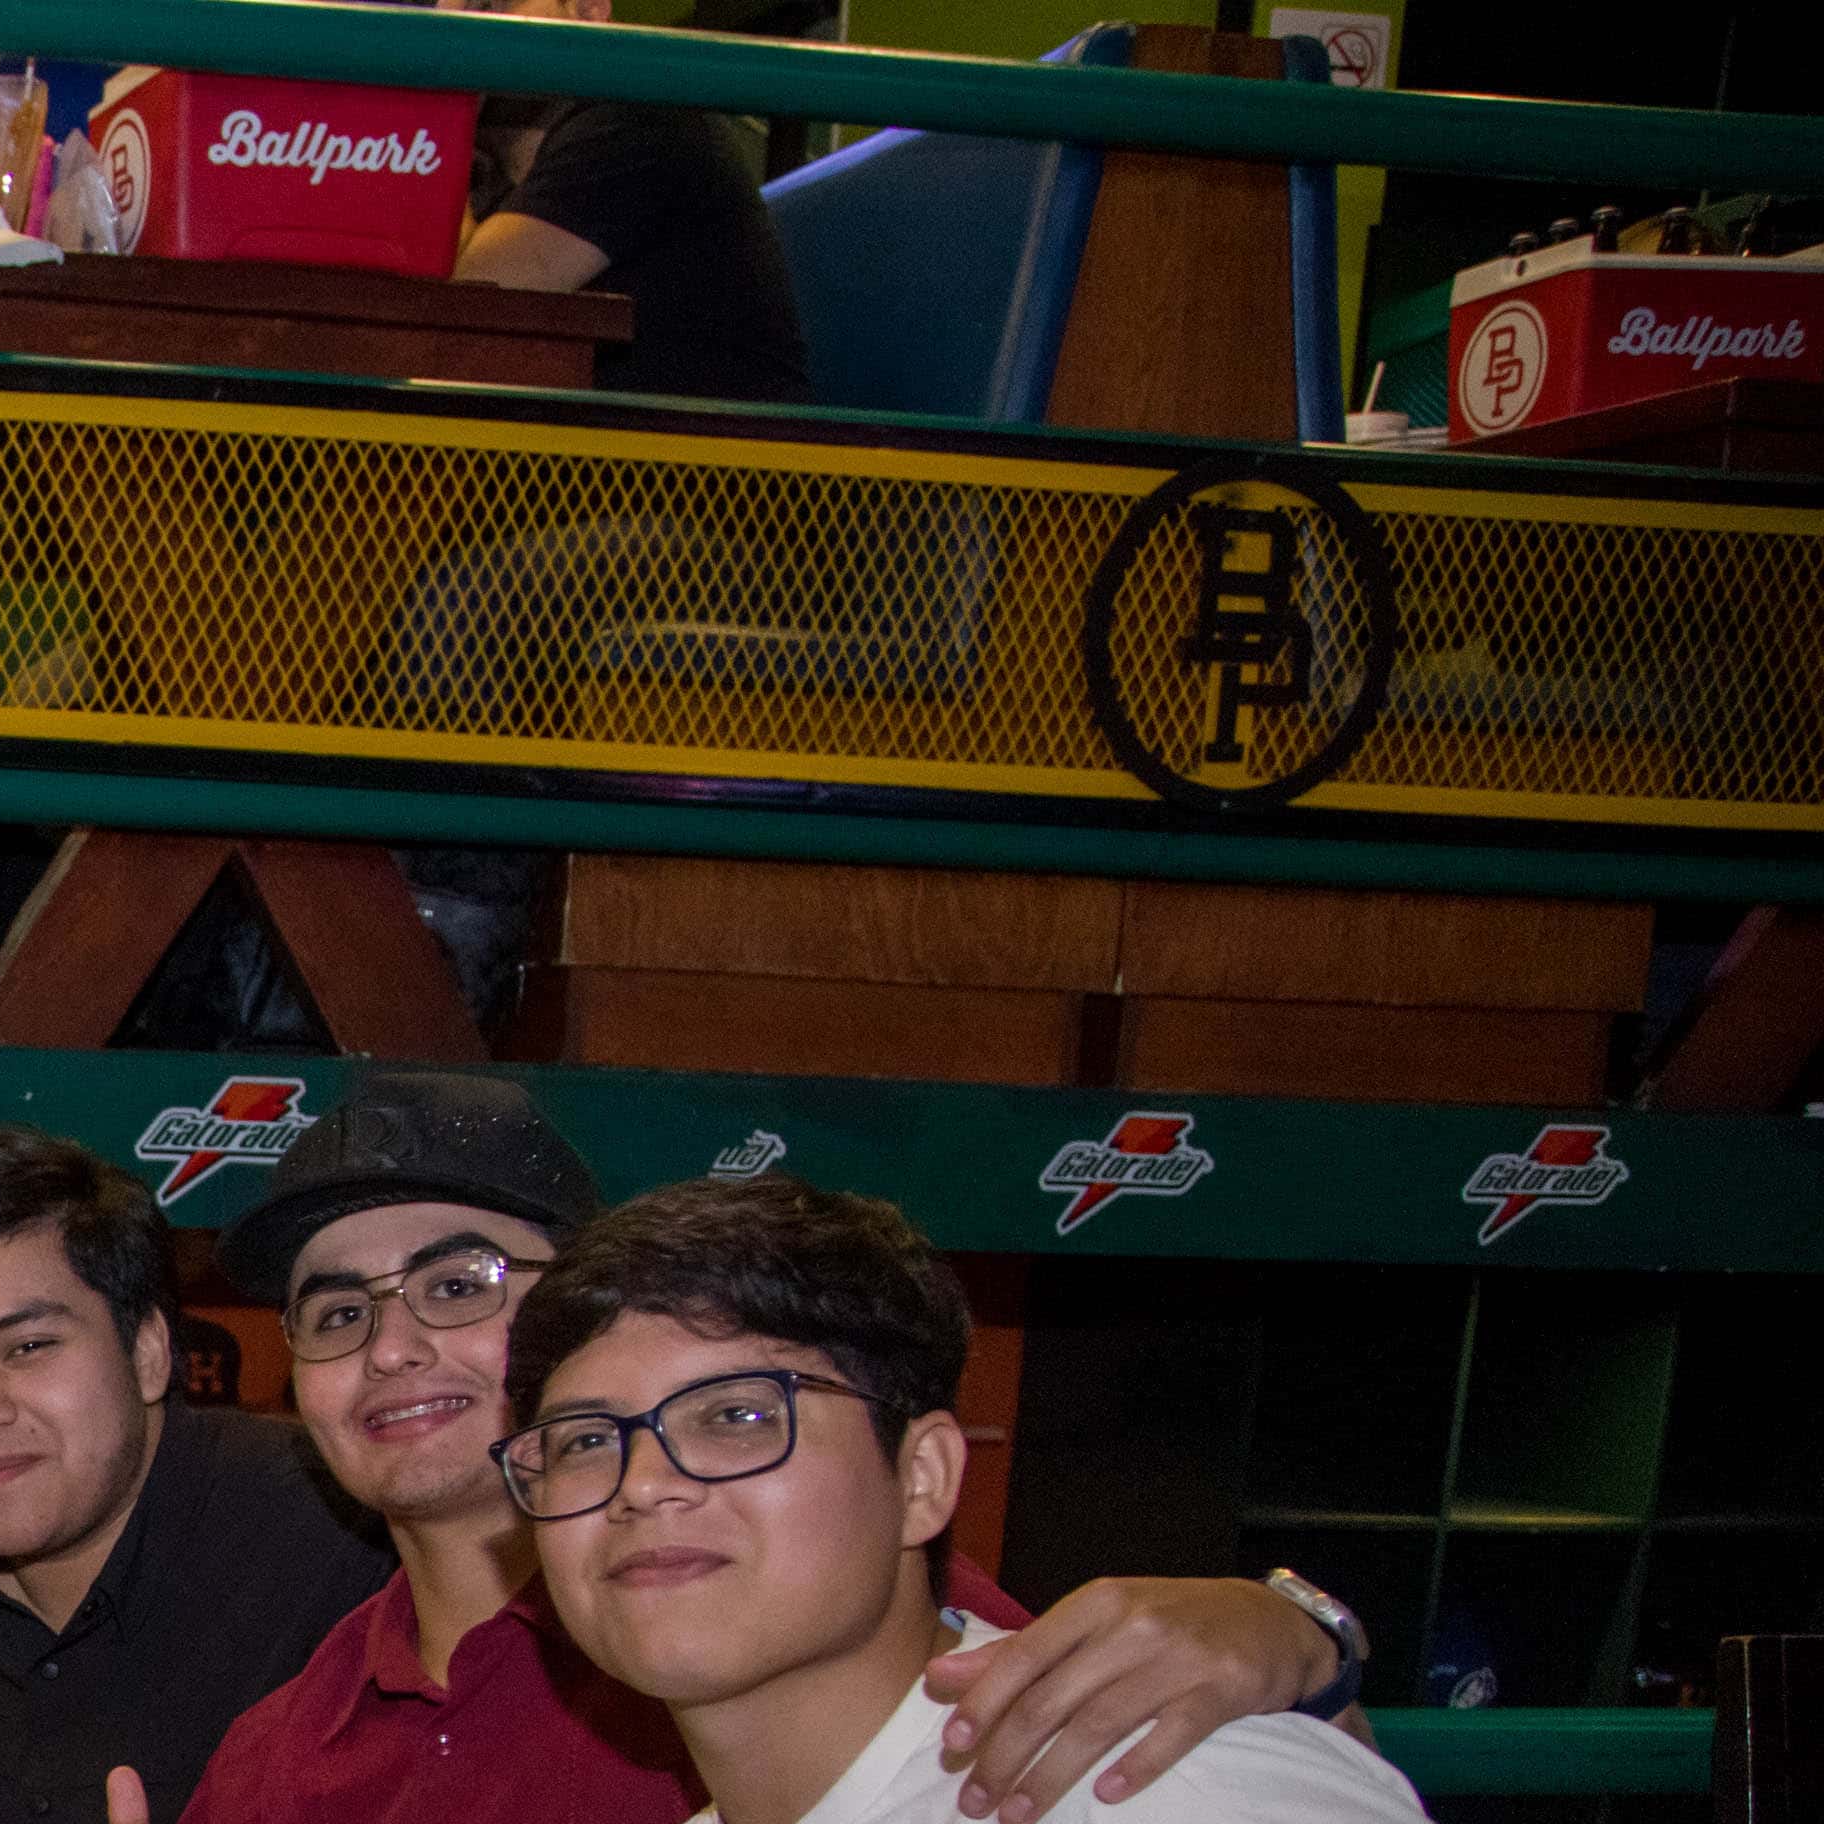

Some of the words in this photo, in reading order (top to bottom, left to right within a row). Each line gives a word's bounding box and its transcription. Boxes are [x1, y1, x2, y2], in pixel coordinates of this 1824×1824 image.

[207, 109, 443, 186] Ballpark
[1607, 306, 1806, 370] Ballpark
[1054, 1151, 1195, 1181] Gatorade
[1475, 1163, 1612, 1192] Gatorade
